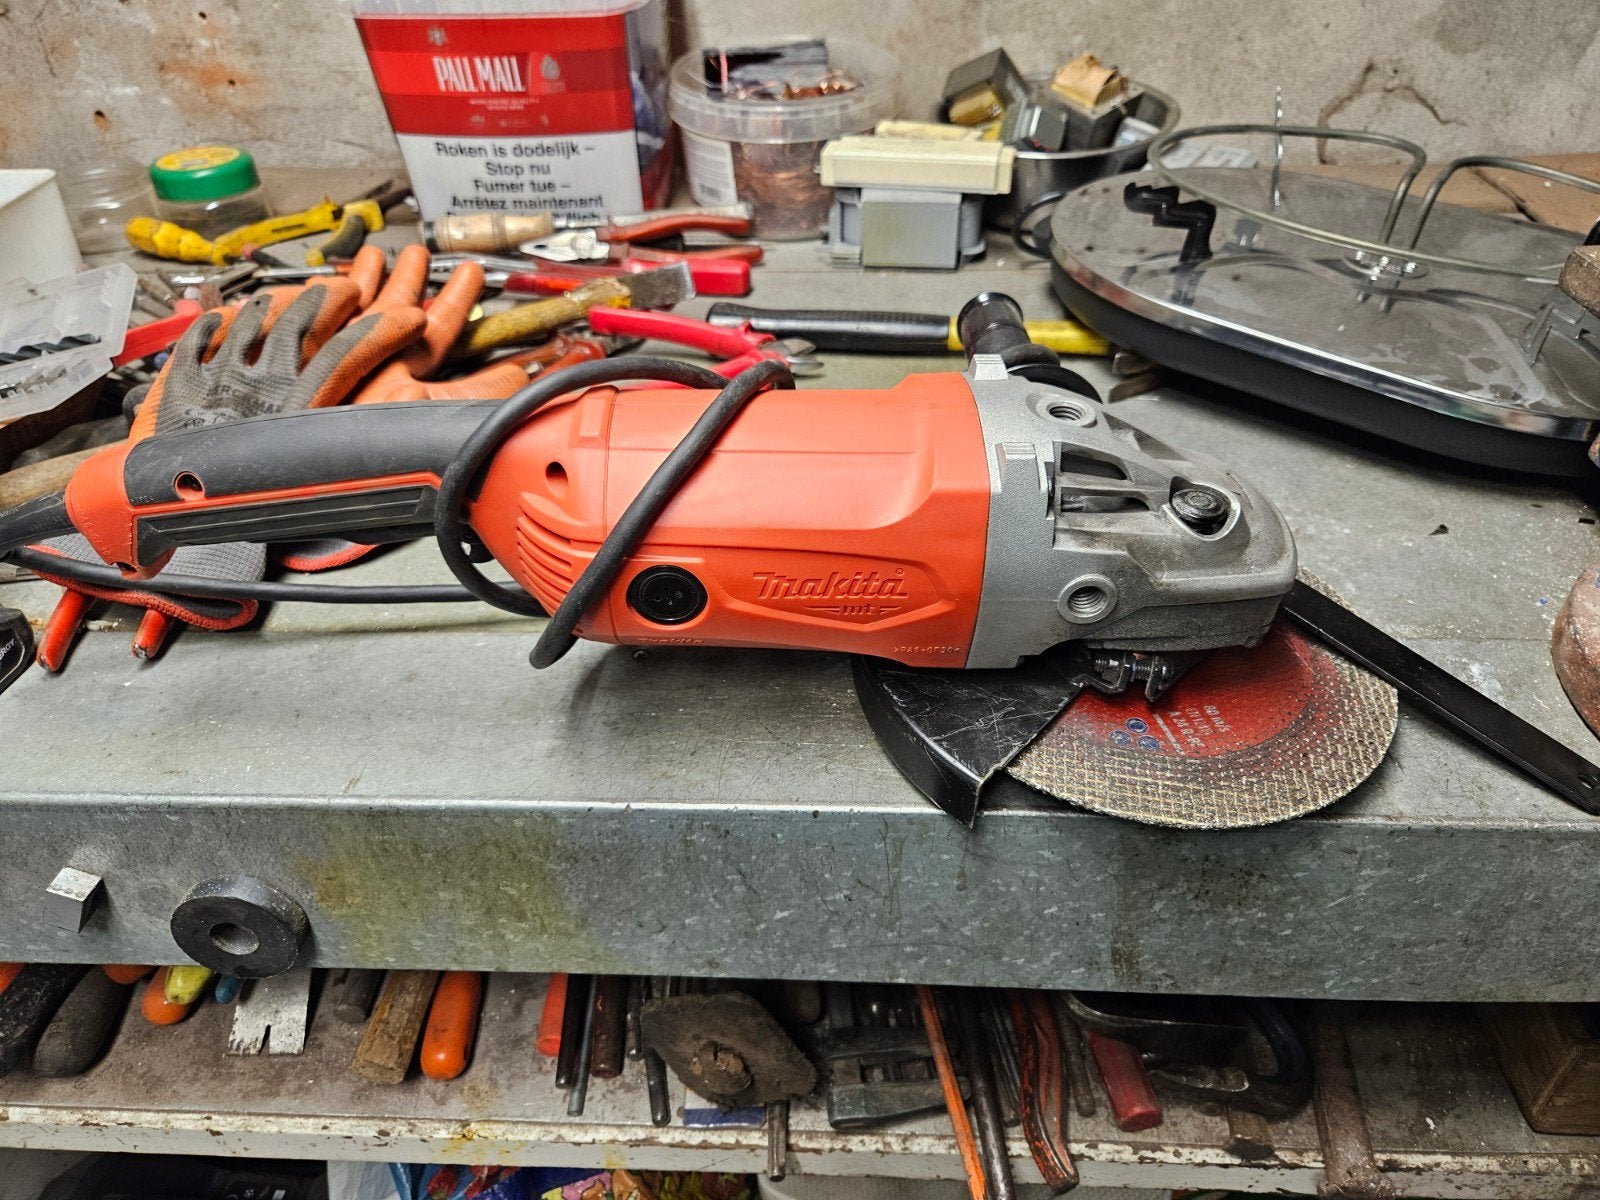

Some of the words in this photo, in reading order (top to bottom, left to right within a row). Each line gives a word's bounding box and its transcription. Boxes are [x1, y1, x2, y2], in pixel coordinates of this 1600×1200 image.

[432, 55, 479, 93] PALL
[473, 55, 527, 93] MALL
[435, 141, 487, 158] Roken
[493, 142, 508, 158] is
[513, 141, 581, 160] dodelijk
[486, 162, 525, 177] Stop
[530, 162, 551, 175] nu
[474, 179, 525, 193] Fumer
[531, 180, 557, 193] tue
[452, 195, 509, 210] Arrêtez
[513, 195, 604, 210] maintenant
[842, 603, 876, 615] mt
